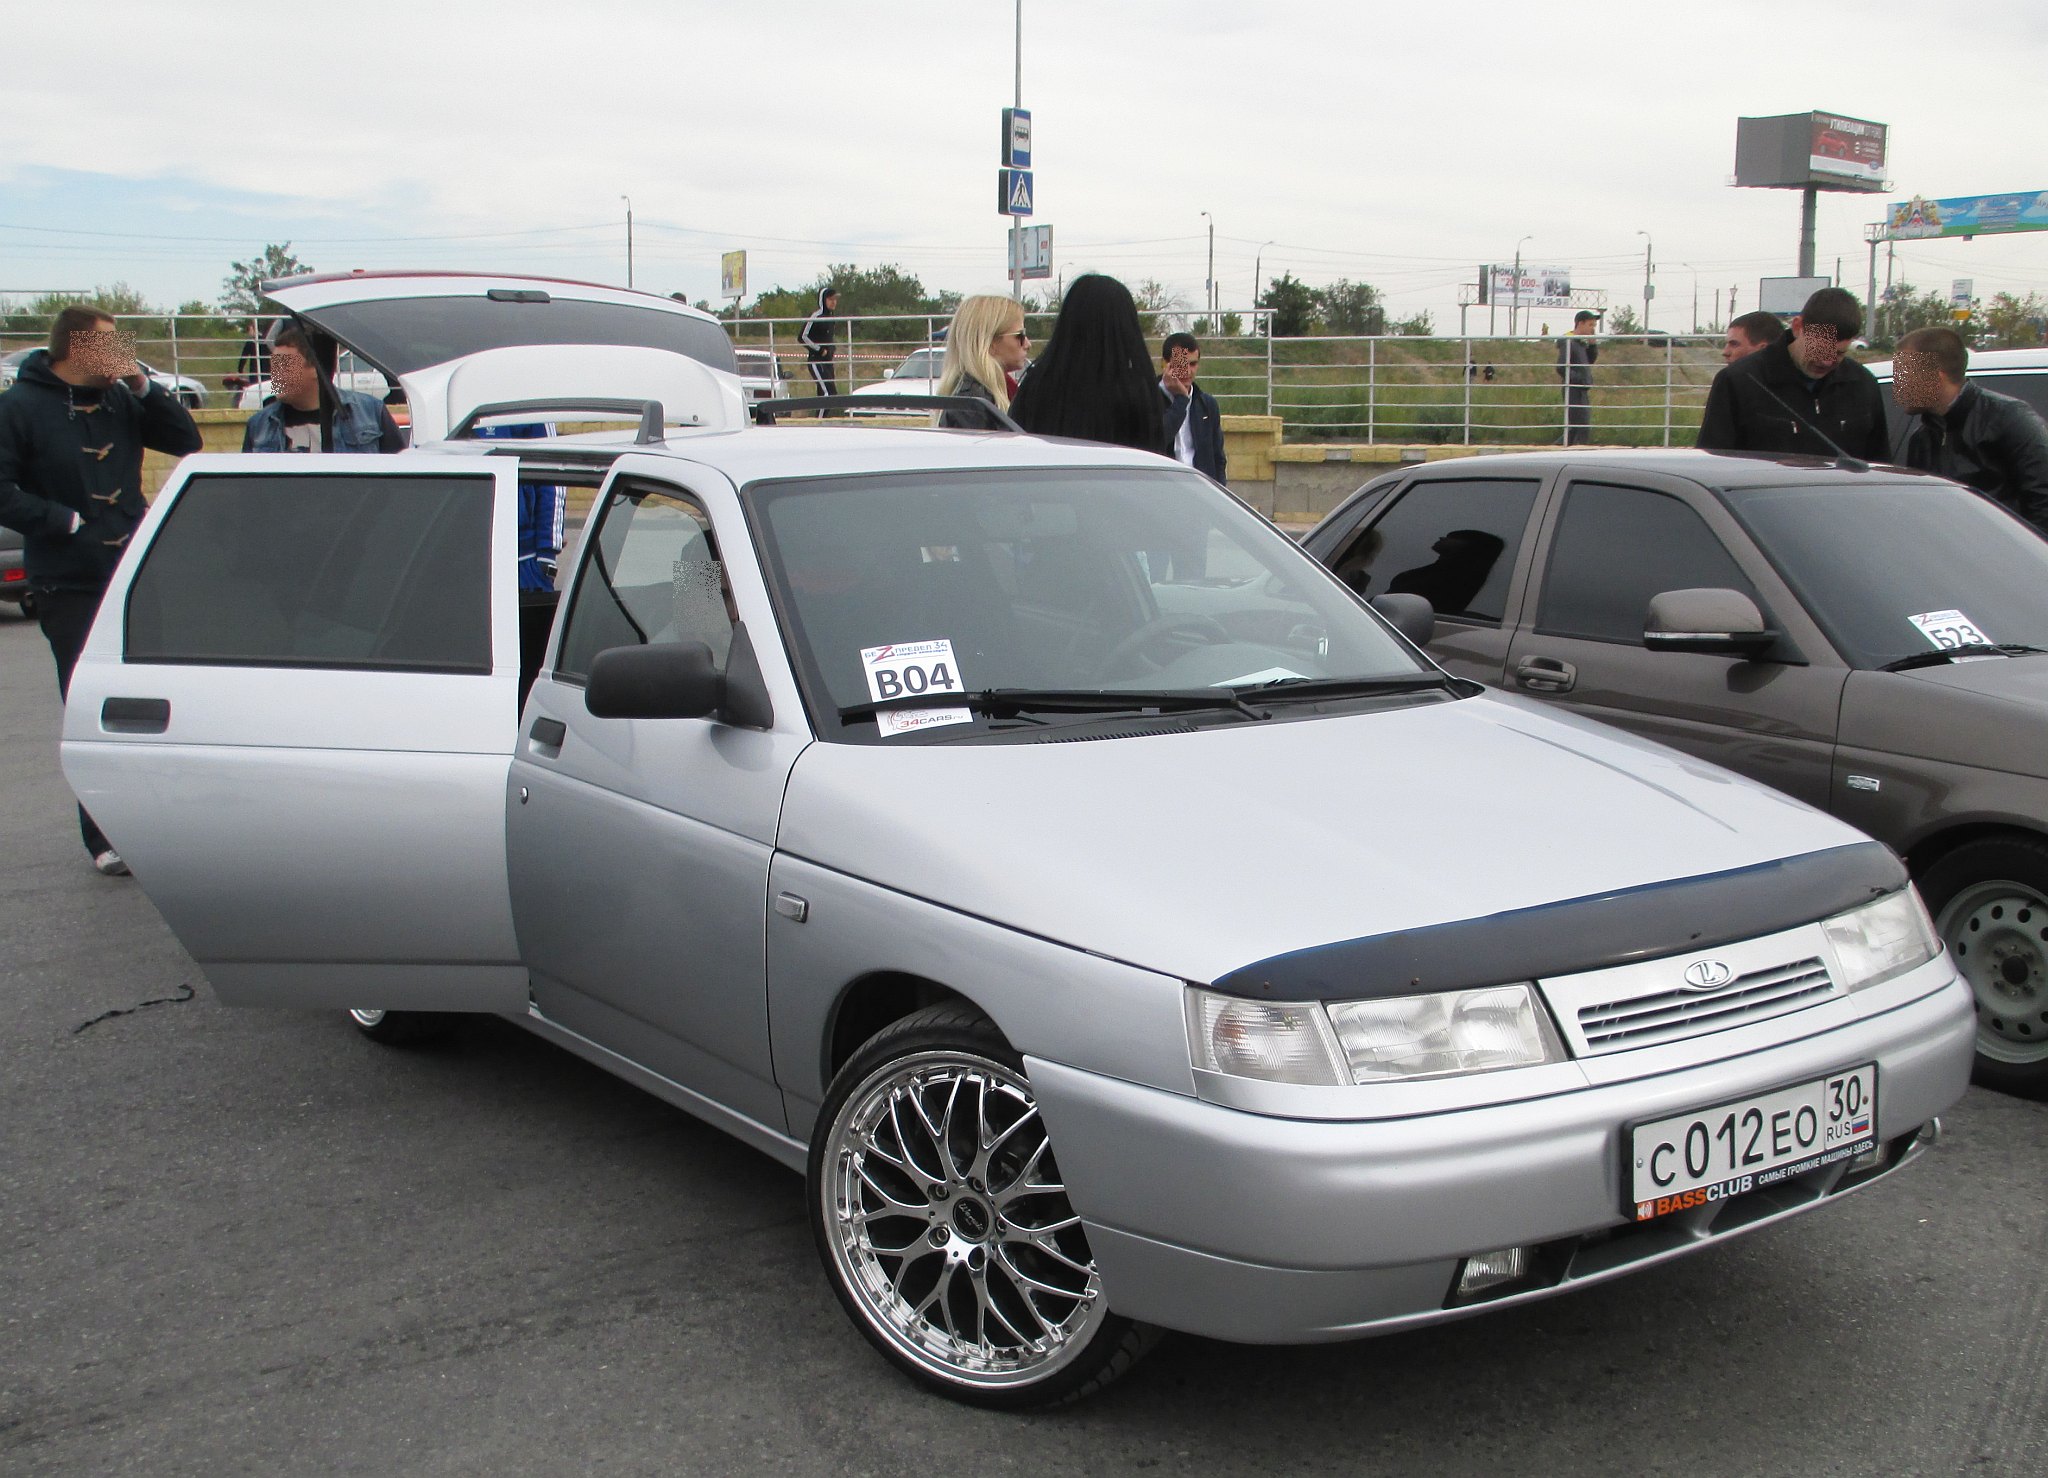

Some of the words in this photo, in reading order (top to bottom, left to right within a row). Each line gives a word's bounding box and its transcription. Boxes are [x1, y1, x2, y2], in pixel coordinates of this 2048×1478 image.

[1490, 267, 1527, 276] ИНОМАКА
[934, 641, 948, 650] 34
[1829, 1075, 1861, 1122] 30
[1827, 1122, 1851, 1142] RUS
[1758, 1169, 1787, 1185] САМЫЕ
[1787, 1159, 1820, 1178] ГРОМКИЕ
[1820, 1150, 1852, 1169] МАШИНЫ
[1852, 1140, 1874, 1156] ЗДЕСЬ
